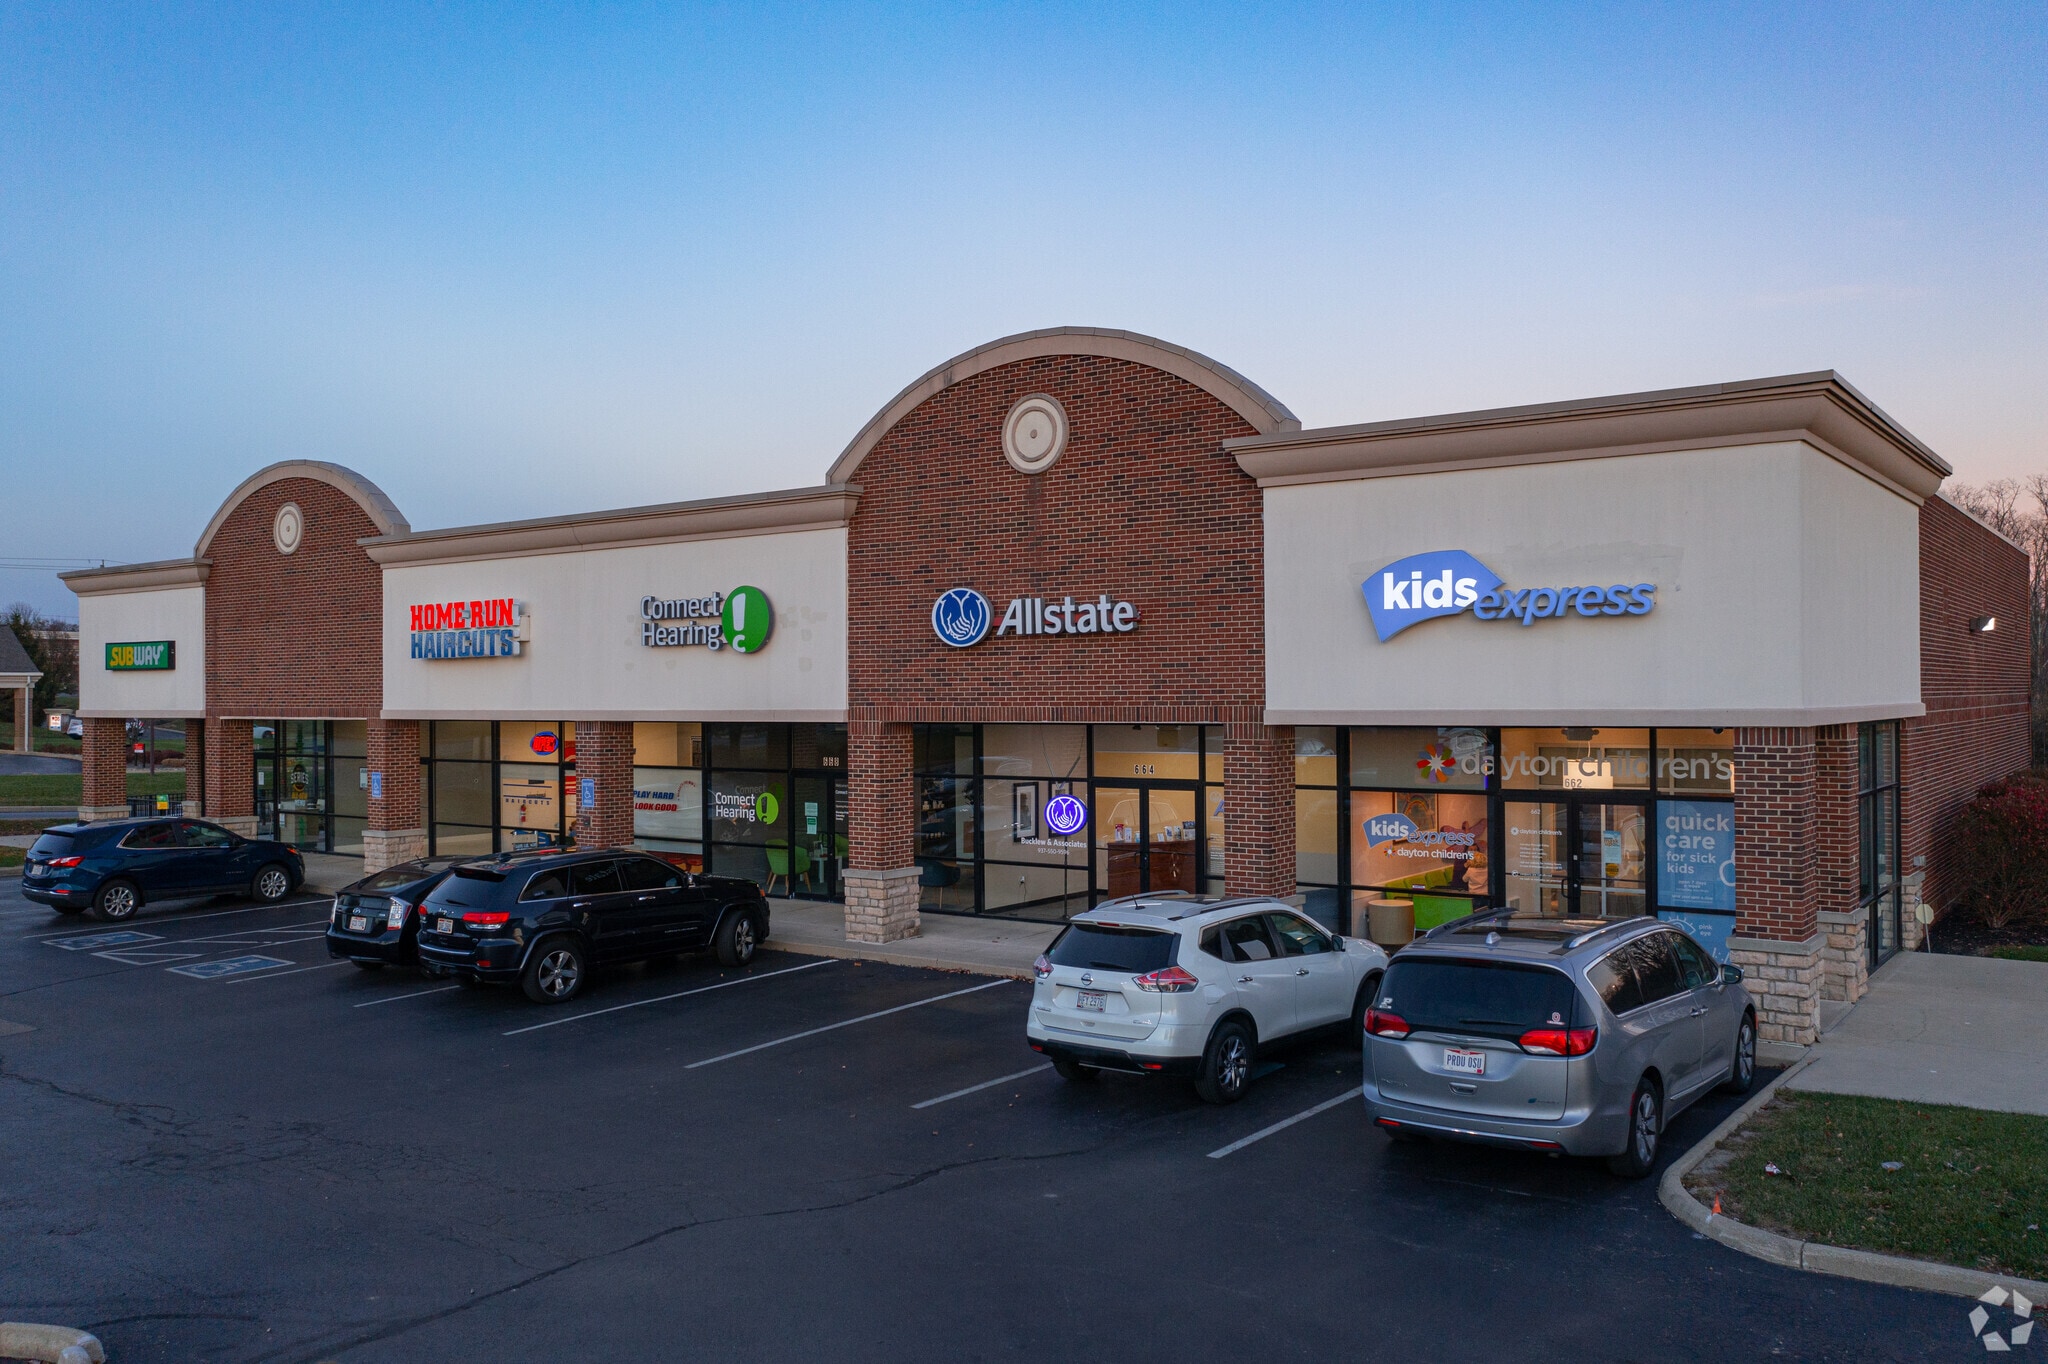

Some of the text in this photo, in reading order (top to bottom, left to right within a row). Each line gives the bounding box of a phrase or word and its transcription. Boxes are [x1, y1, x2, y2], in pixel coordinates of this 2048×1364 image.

[641, 591, 721, 620] Connect
[1383, 569, 1656, 626] kids express
[410, 598, 514, 631] HOME RUN
[997, 594, 1135, 636] Allstate
[410, 629, 514, 659] HAIRCUTS
[641, 621, 721, 651] Hearing
[110, 644, 165, 667] SUBWAY
[1134, 765, 1155, 775] 664
[1461, 751, 1733, 781] dayton children's
[1564, 779, 1583, 788] 662
[633, 790, 675, 800] PLAY HARD
[715, 792, 756, 807] Connect
[635, 803, 678, 812] LOOK GOOD
[715, 805, 756, 822] Hearing
[1665, 813, 1731, 833] quick
[1371, 820, 1476, 847] kids express
[1020, 838, 1088, 848] Bucklew & Associates
[1665, 834, 1717, 850] care
[1397, 847, 1475, 860] dayton children's
[1666, 851, 1717, 864] for sick
[1666, 863, 1695, 874] kids
[1698, 924, 1713, 932] pink
